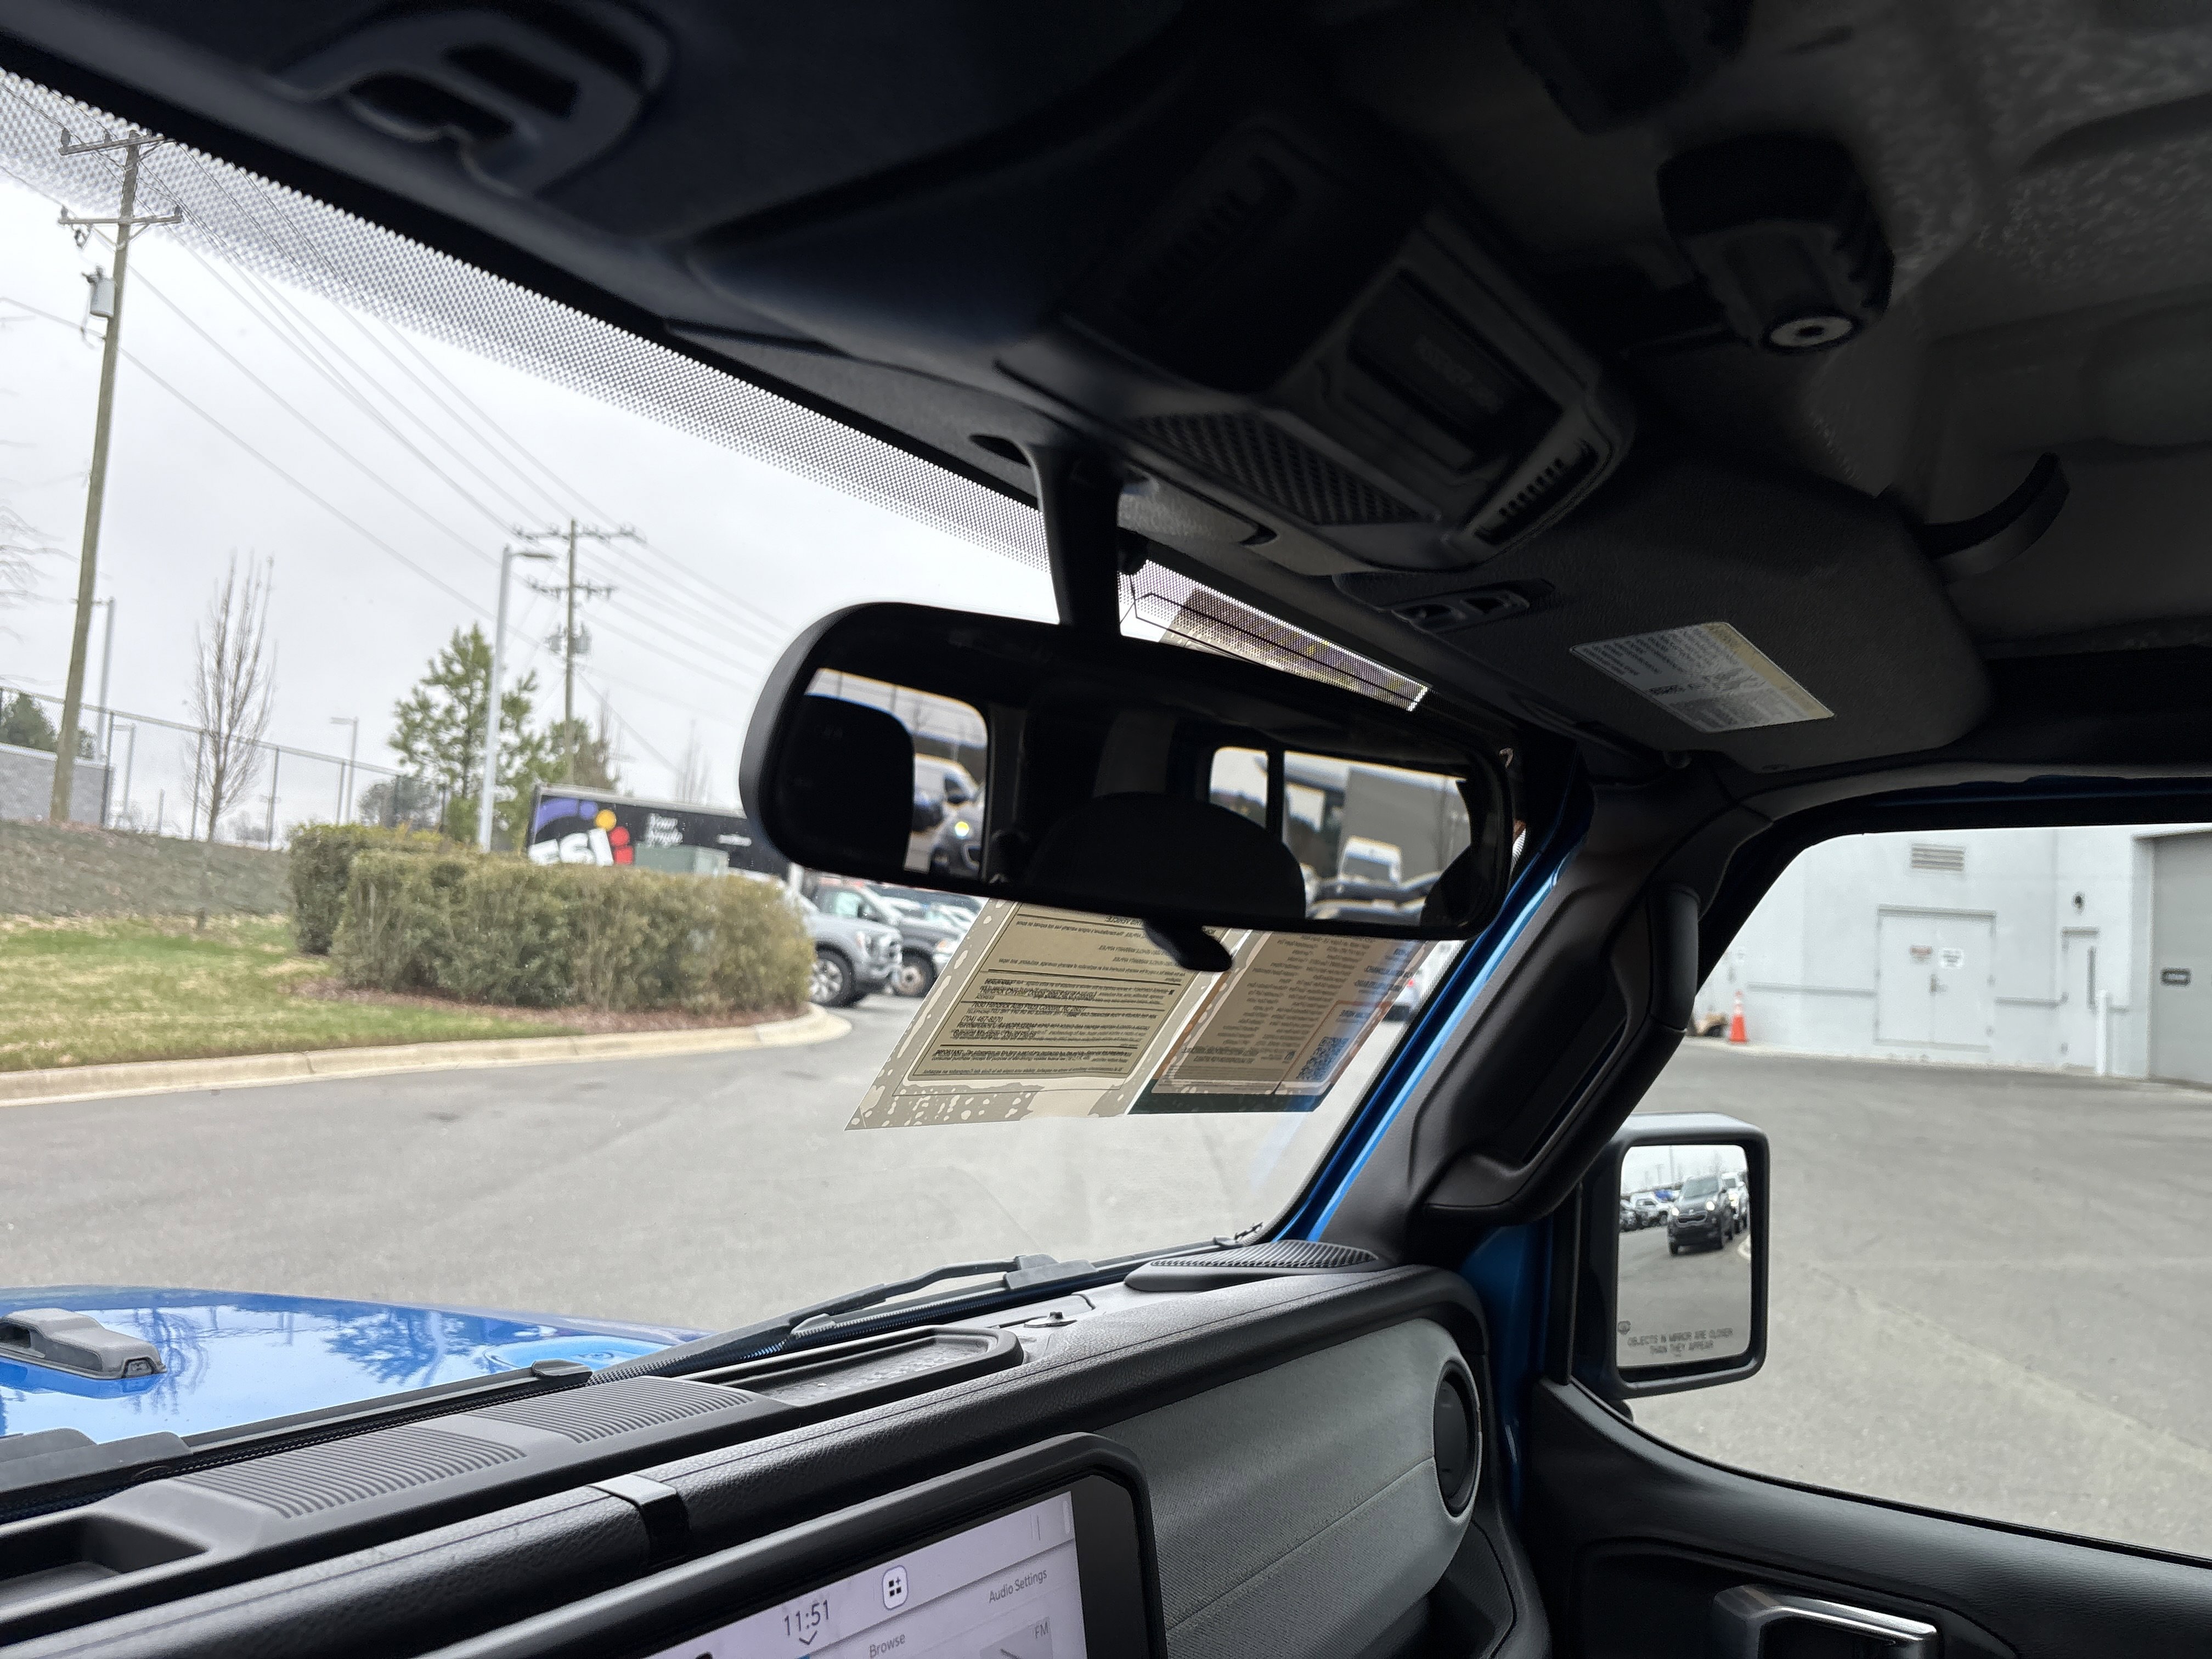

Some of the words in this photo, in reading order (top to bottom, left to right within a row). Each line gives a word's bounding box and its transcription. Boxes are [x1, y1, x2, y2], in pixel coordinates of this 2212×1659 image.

[989, 1582, 1013, 1604] Audio
[1014, 1568, 1048, 1597] Settings
[783, 1599, 831, 1636] 11:51
[1034, 1622, 1050, 1639] FM
[868, 1632, 906, 1658] Browse
